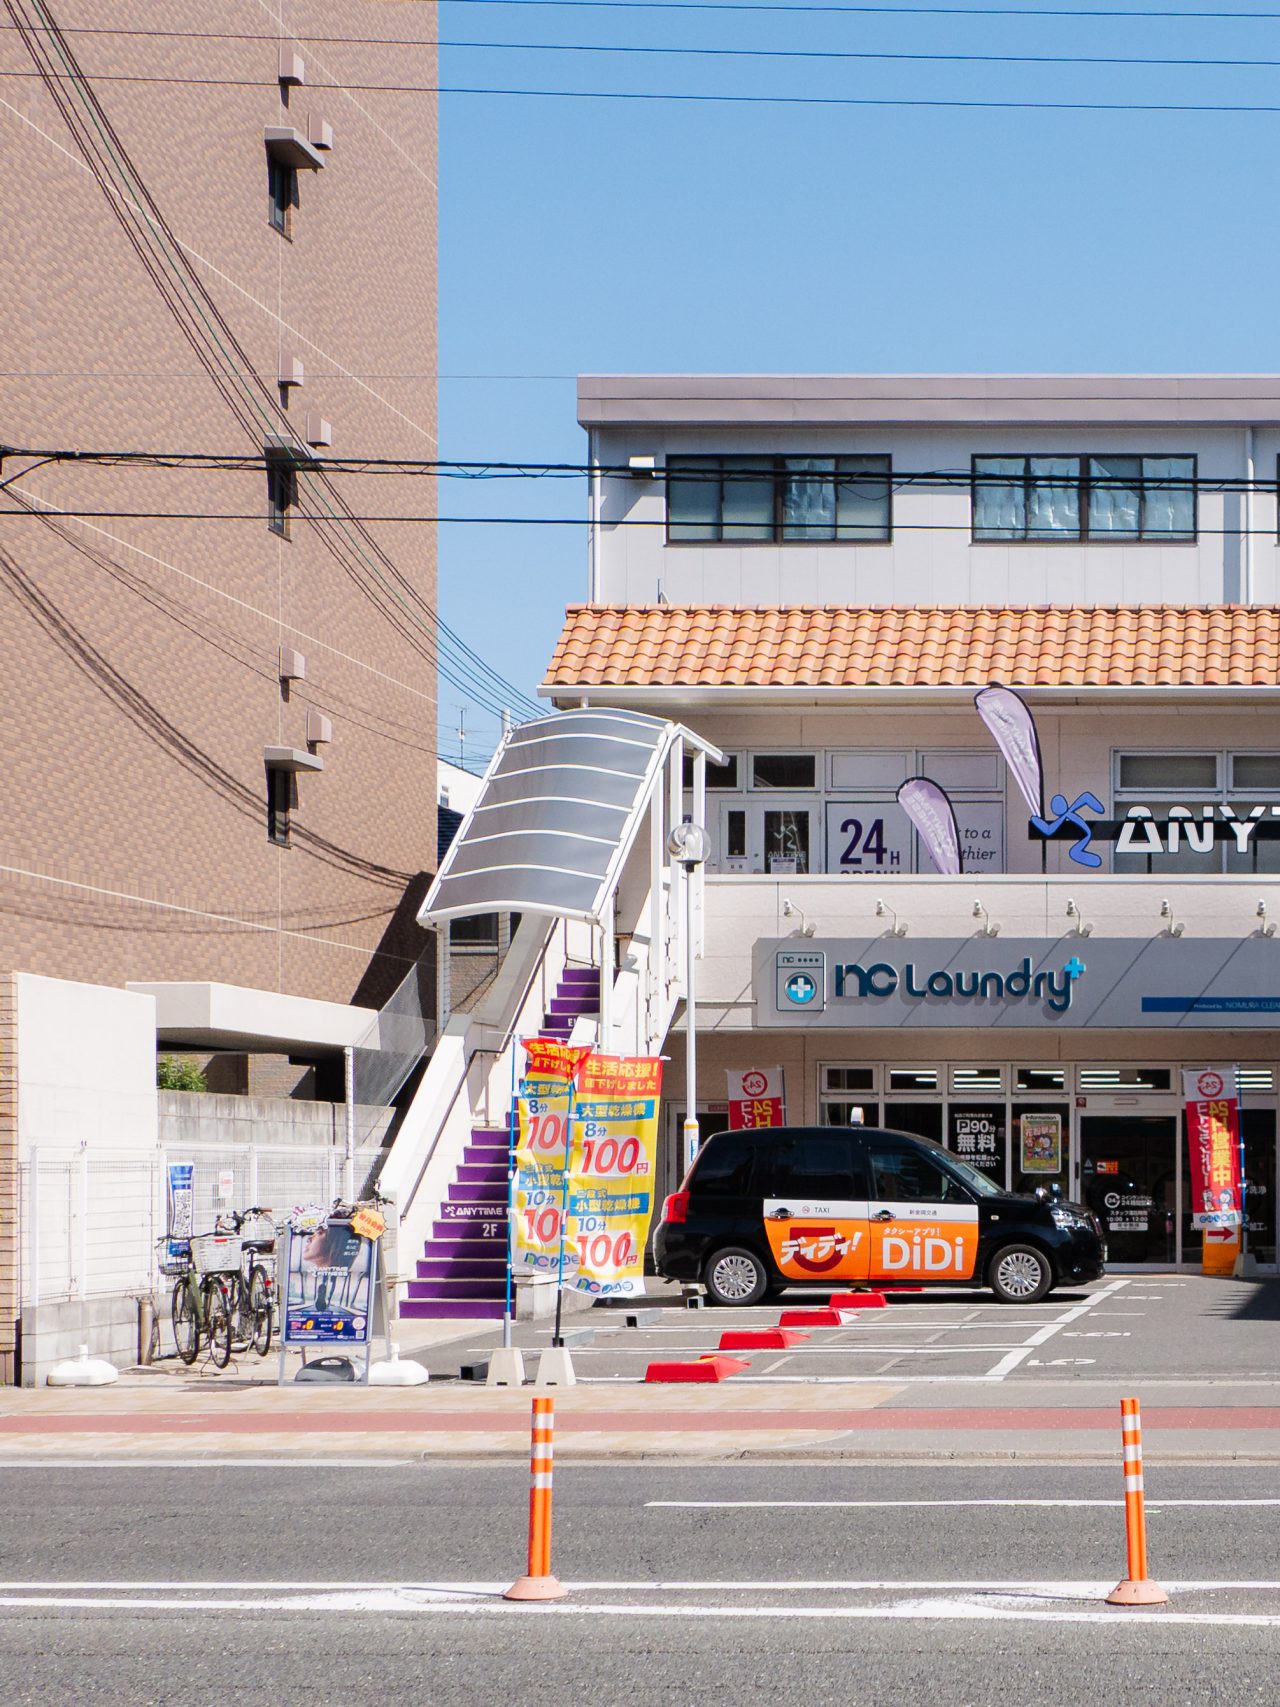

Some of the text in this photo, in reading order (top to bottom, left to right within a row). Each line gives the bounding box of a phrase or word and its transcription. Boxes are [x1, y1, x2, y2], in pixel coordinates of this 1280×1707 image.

[964, 828, 978, 839] to
[835, 962, 899, 999] nc
[585, 1060, 659, 1078] 生活応援!
[584, 1078, 657, 1090] 値下げしました
[528, 1099, 548, 1115] 8分
[581, 1102, 646, 1118] 大型乾燥機
[584, 1122, 608, 1138] 8分
[957, 1120, 996, 1134] P 90分
[957, 1134, 996, 1153] 無料
[581, 1137, 649, 1175] 100円
[526, 1190, 555, 1206] 10分
[575, 1198, 641, 1213] 小型乾燥機
[455, 1207, 503, 1216] ANYTIME
[482, 1223, 498, 1237] 2F
[577, 1216, 607, 1232] 10分
[883, 1226, 942, 1237] タクシーアプリ!
[576, 1231, 639, 1268] 100円
[780, 1231, 863, 1266] ディディ!
[882, 1236, 965, 1272] DiDi
